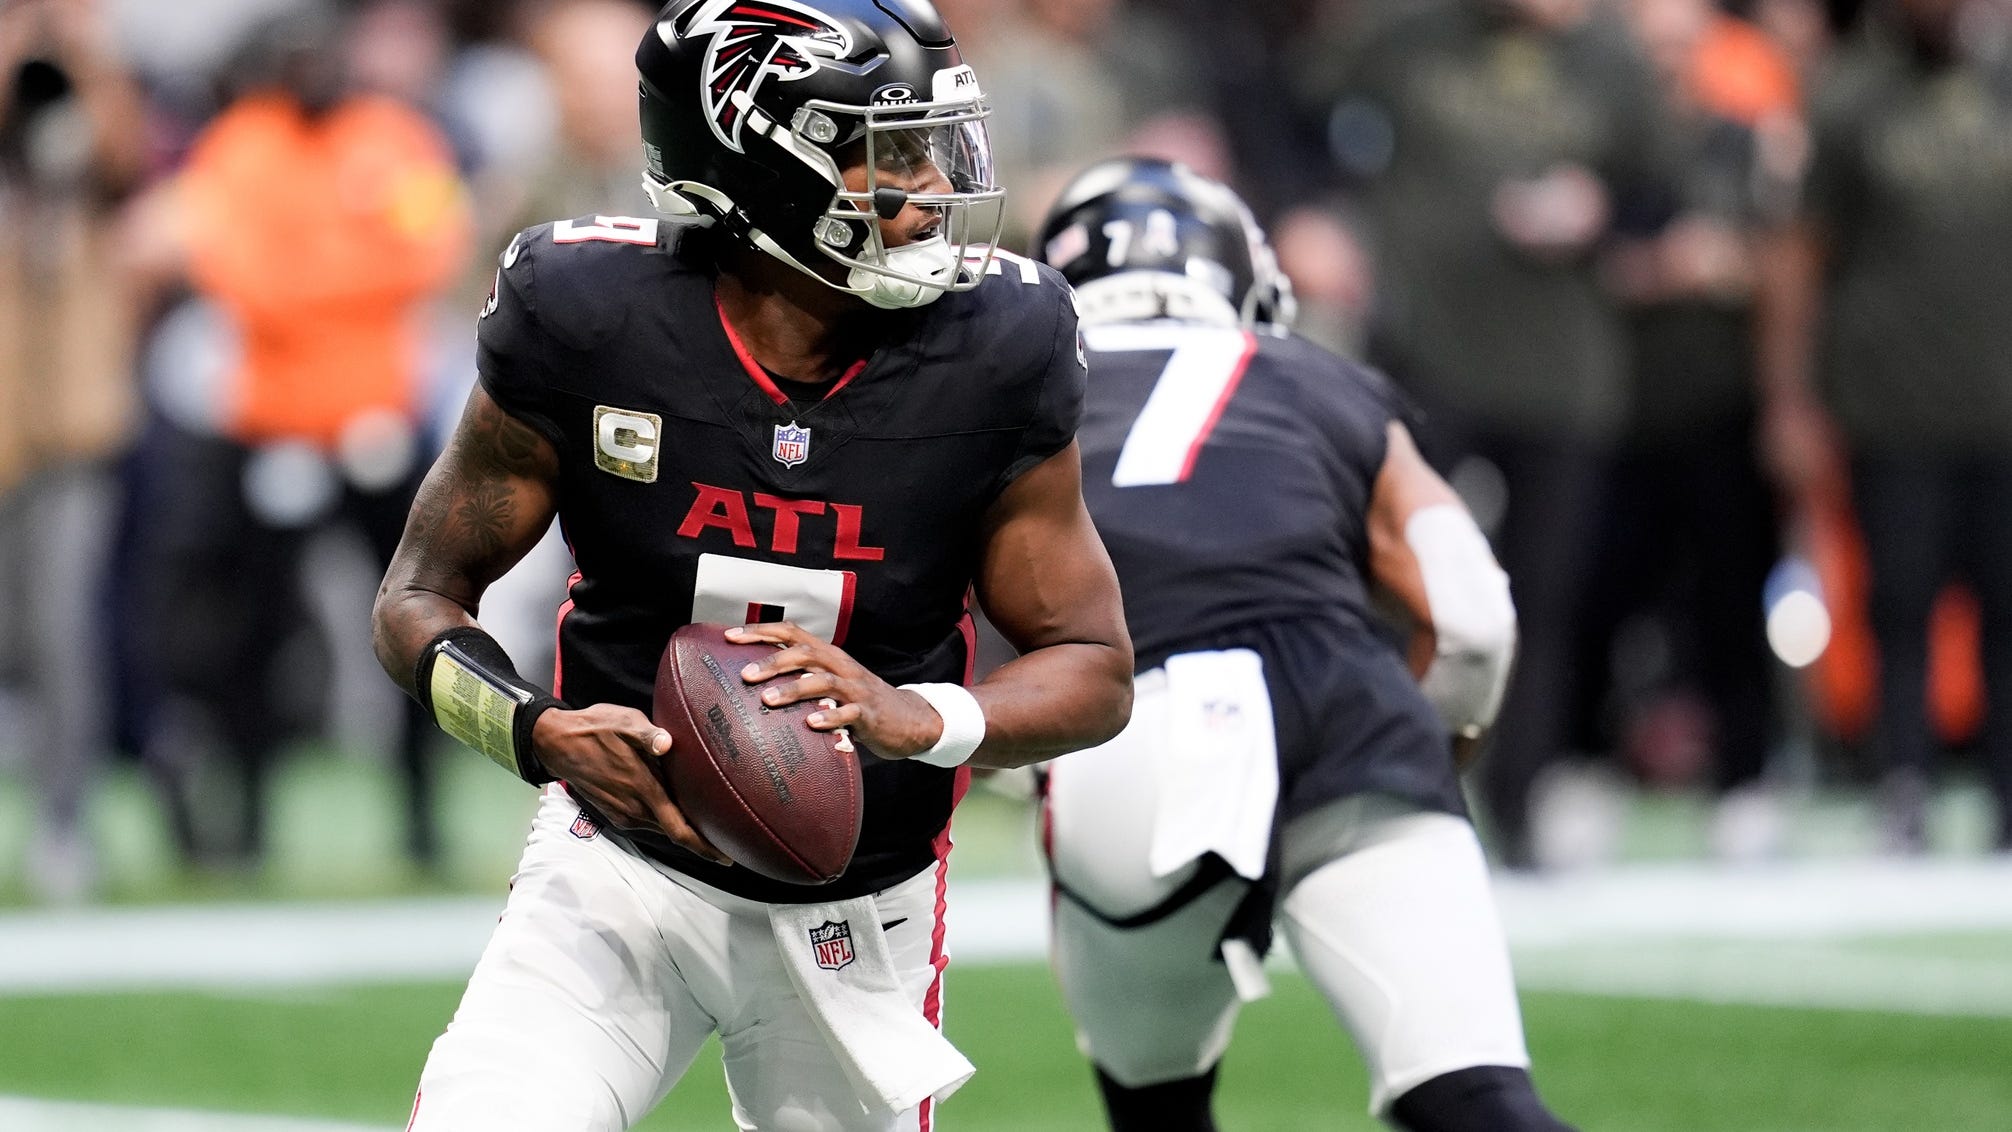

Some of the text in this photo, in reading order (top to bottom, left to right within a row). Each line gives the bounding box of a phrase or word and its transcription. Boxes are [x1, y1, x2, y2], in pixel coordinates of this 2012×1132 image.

[953, 71, 976, 88] ATL
[1102, 219, 1133, 267] 7
[1079, 327, 1259, 487] 7
[599, 412, 656, 464] C
[778, 442, 802, 460] NFL
[677, 481, 885, 560] ATL
[817, 939, 851, 965] NFL
